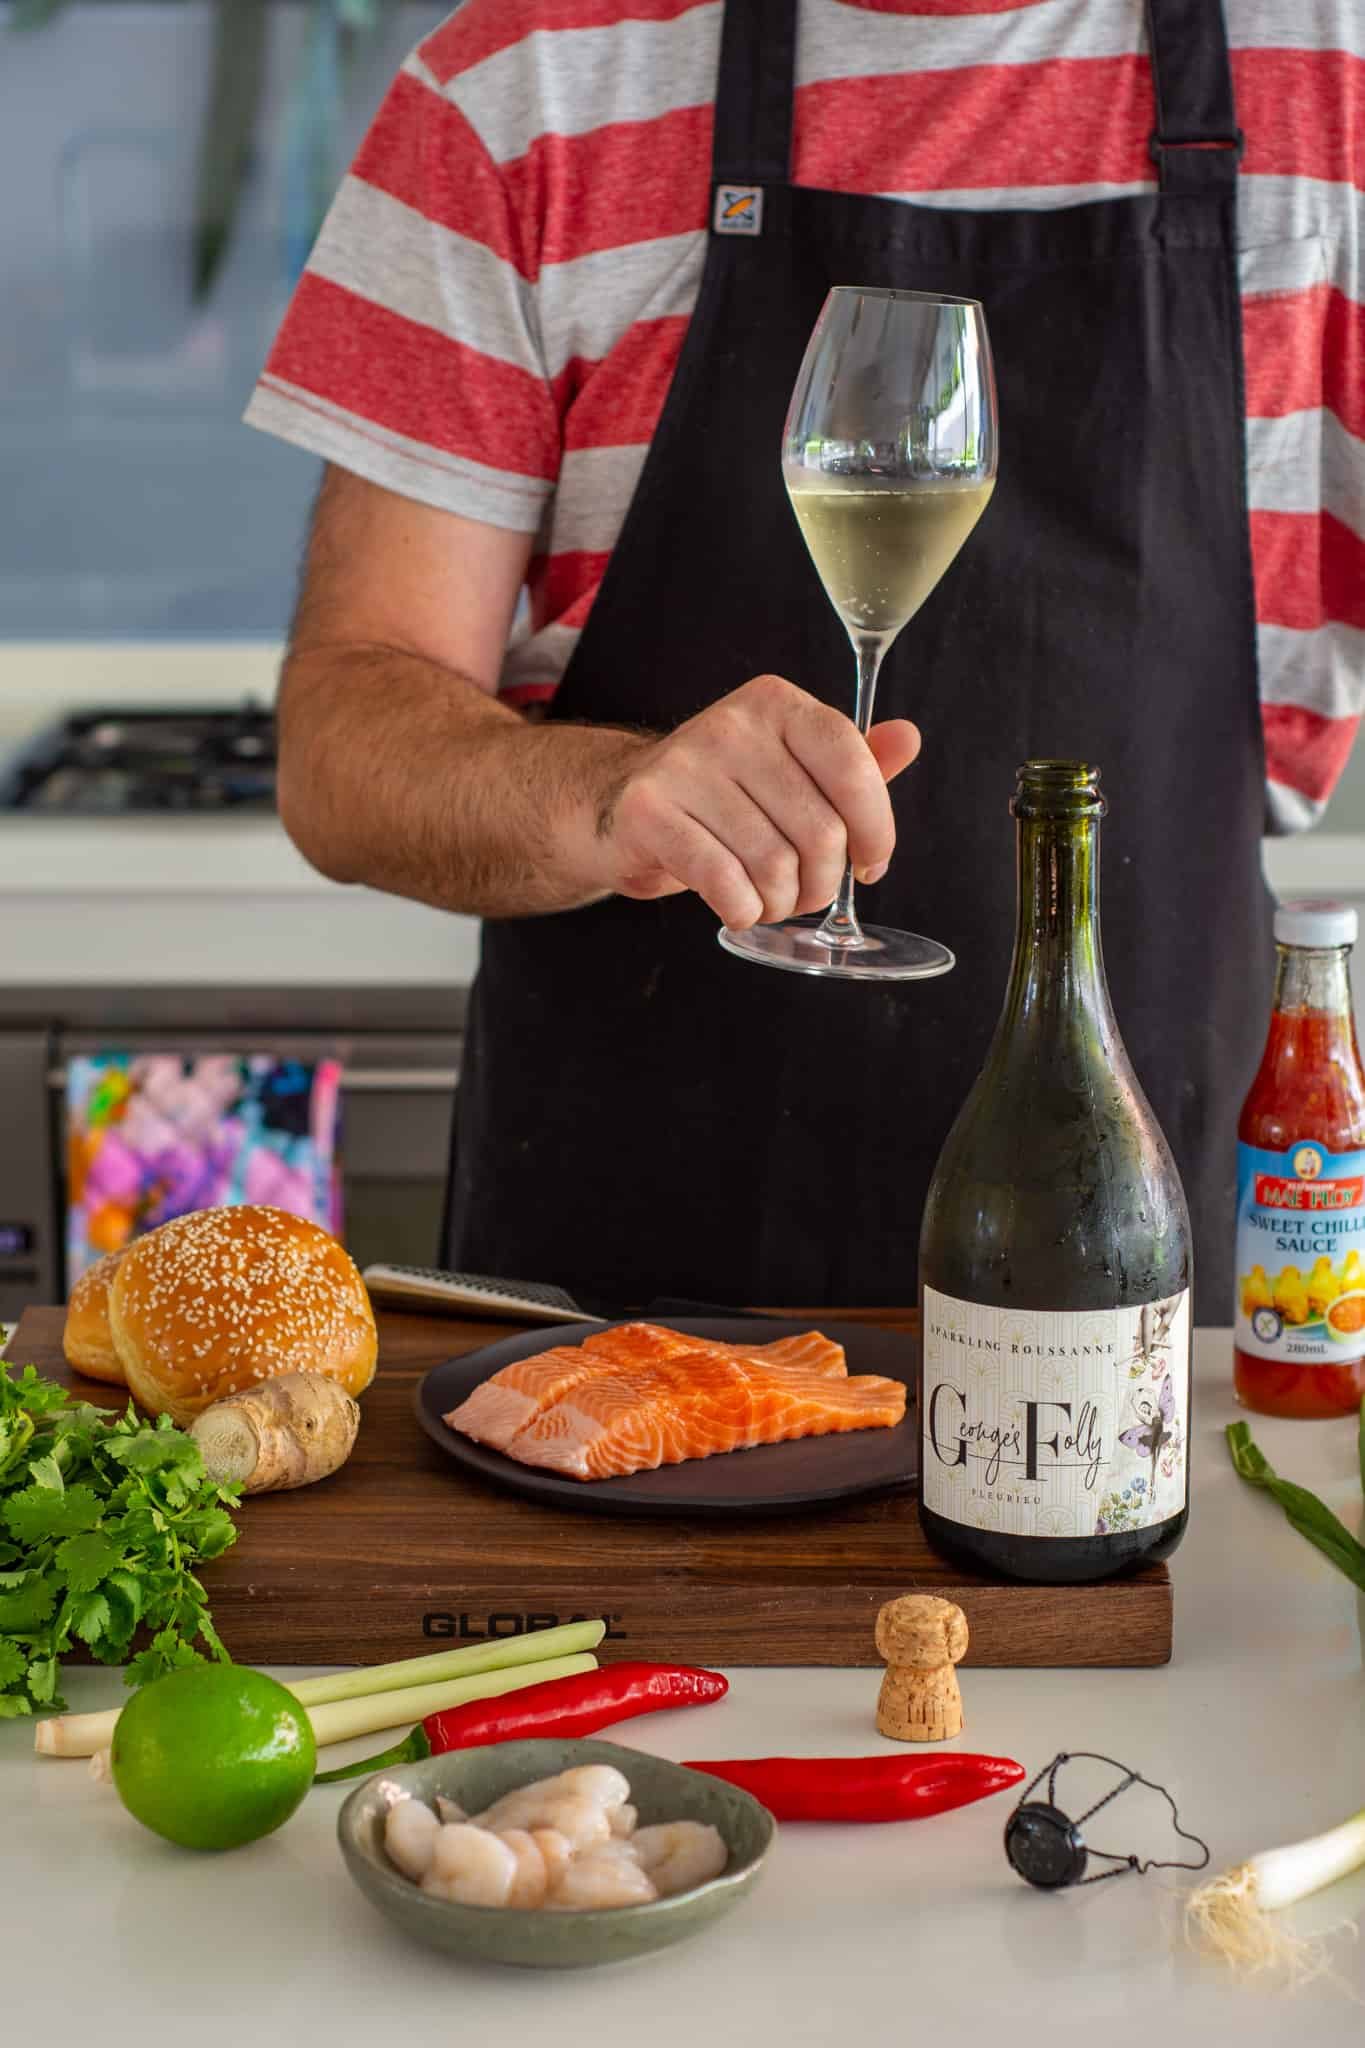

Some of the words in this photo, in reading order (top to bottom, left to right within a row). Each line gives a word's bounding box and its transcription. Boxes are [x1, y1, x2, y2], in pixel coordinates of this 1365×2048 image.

[1263, 1186, 1303, 1208] MAE
[1249, 1213, 1304, 1234] SWEET
[1276, 1237, 1337, 1253] SAUCE
[930, 1324, 1000, 1351] SPARKLING
[1011, 1343, 1115, 1356] ROUSSANNE
[1015, 1400, 1102, 1490] Folly
[971, 1488, 1041, 1505] FLEURIEU
[423, 1613, 626, 1639] GLOBL
